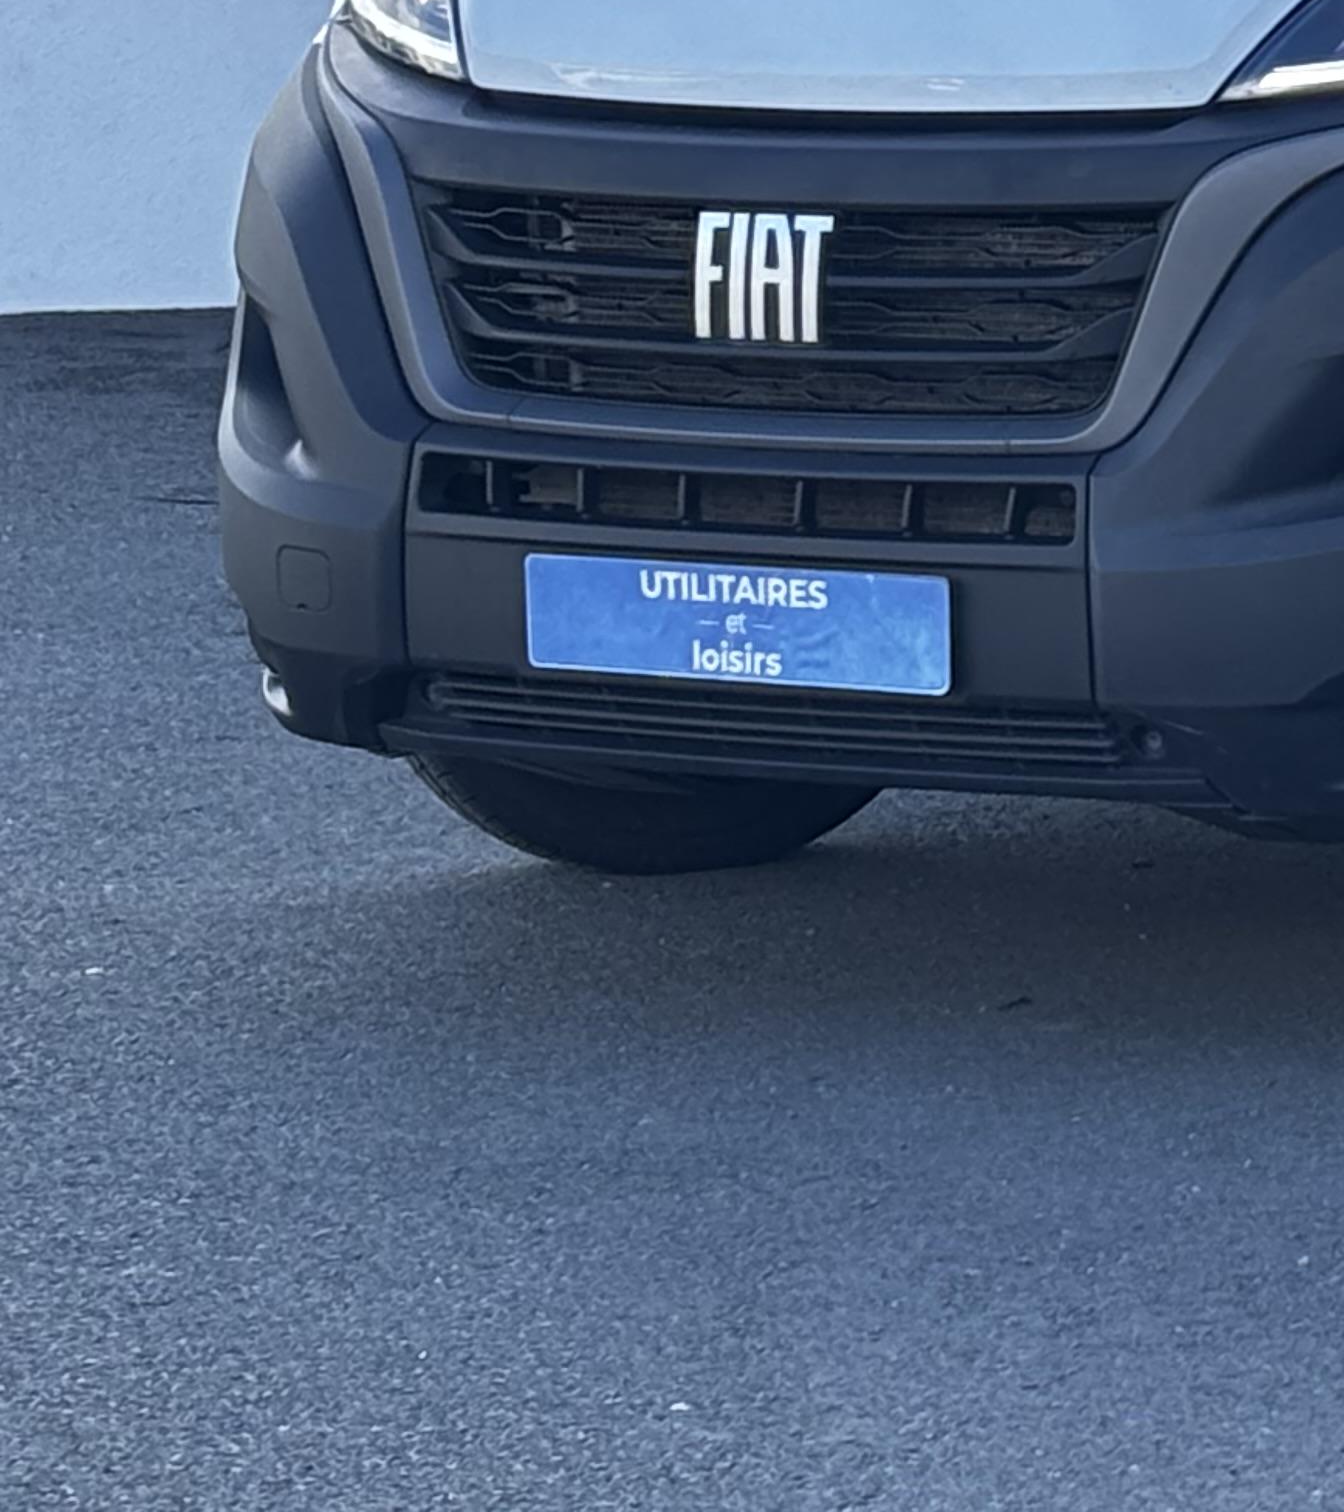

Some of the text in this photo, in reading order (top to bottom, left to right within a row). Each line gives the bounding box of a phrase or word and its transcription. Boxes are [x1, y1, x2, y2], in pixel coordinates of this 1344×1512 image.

[695, 211, 835, 343] FIAT
[639, 569, 829, 610] UTILITAIRES
[725, 612, 747, 635] et
[692, 639, 783, 676] loisirs
